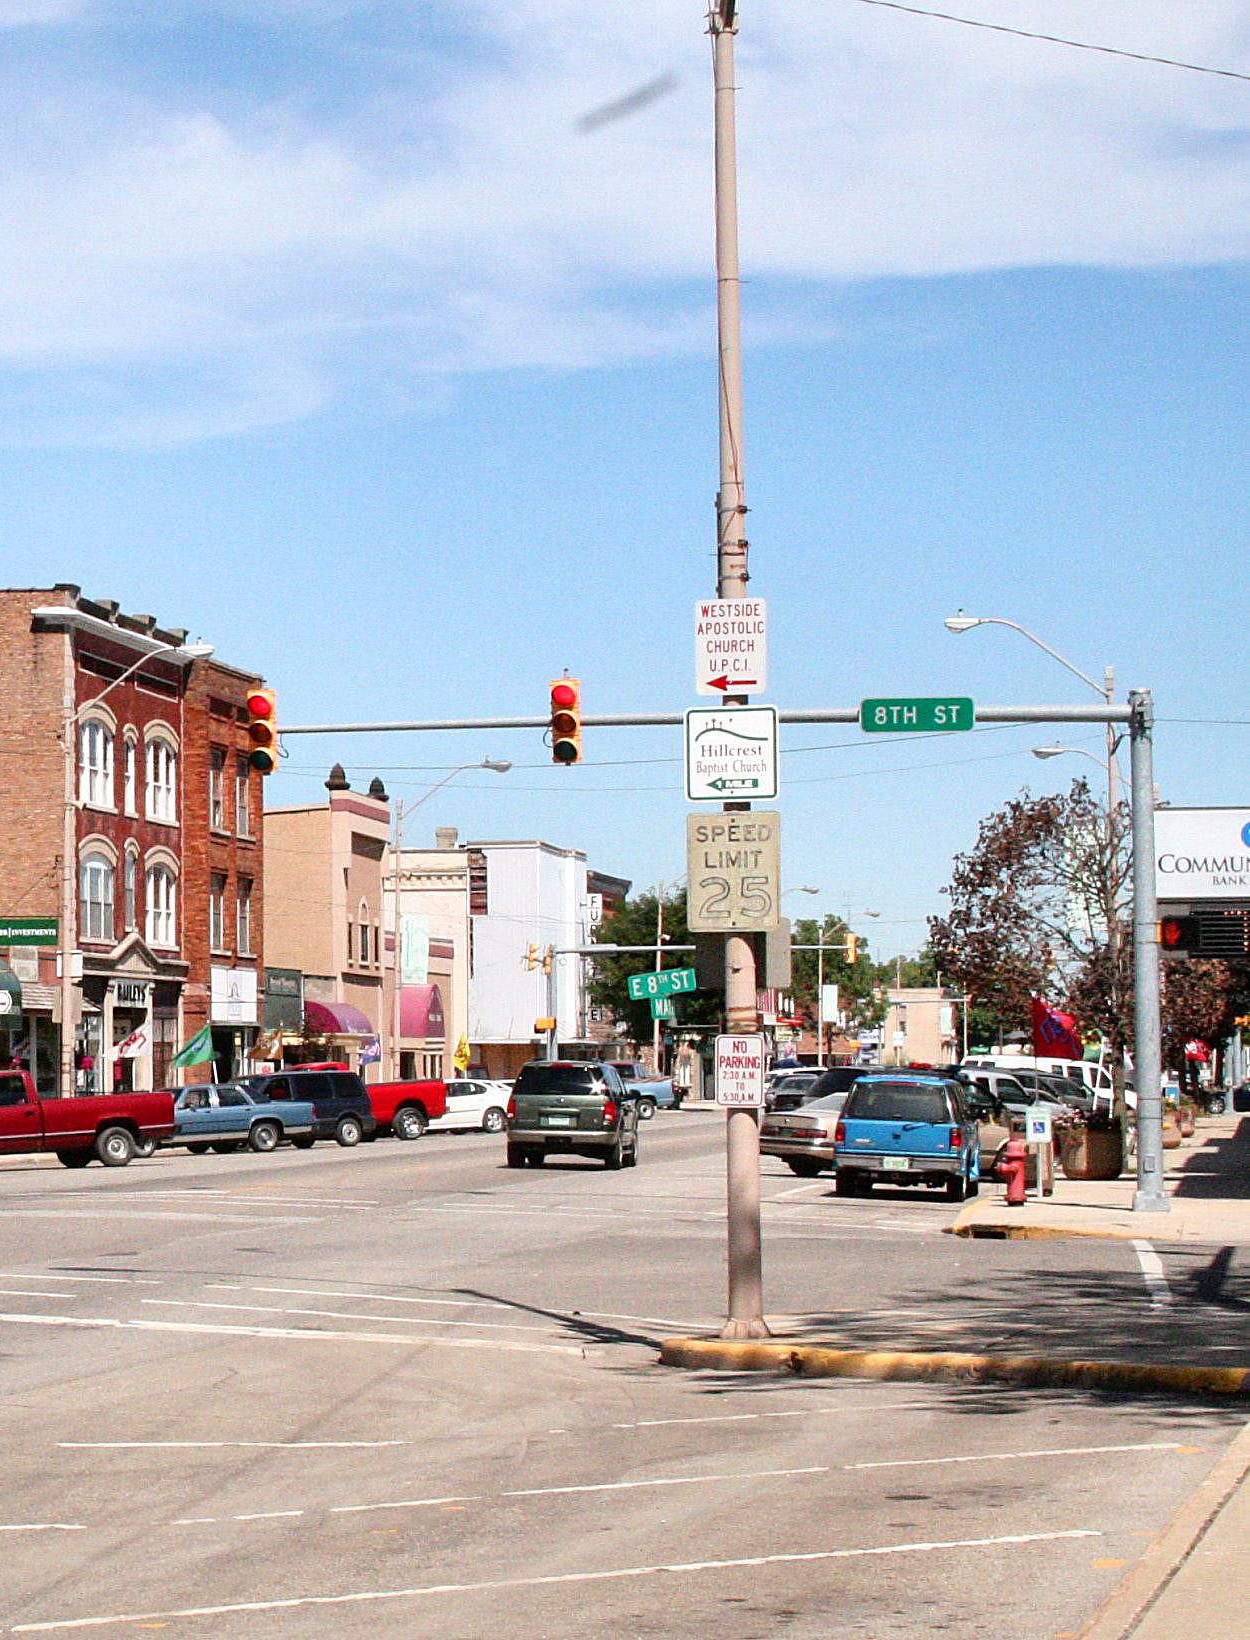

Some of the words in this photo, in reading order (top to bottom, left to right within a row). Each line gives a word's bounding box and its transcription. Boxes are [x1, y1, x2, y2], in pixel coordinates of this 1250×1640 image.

[701, 604, 760, 618] WESTSIDE
[697, 621, 764, 635] APOSTOLIC
[706, 639, 755, 653] CHURCH
[709, 658, 752, 672] U.P.C.I.
[874, 706, 917, 725] 8TH
[934, 705, 960, 724] ST
[701, 744, 763, 758] Hillcrest
[696, 760, 728, 776] Baptist
[732, 759, 767, 773] Church
[696, 825, 771, 842] SPEED
[704, 850, 763, 868] LIMIT
[1213, 875, 1247, 886] BANK
[699, 876, 772, 918] 25
[11, 928, 57, 936] INVESTMENTS
[632, 978, 643, 997] E
[647, 974, 670, 994] 8TH
[671, 970, 690, 991] ST
[732, 1040, 748, 1054] NO
[719, 1055, 761, 1069] PARKING
[736, 1081, 745, 1091] TO
